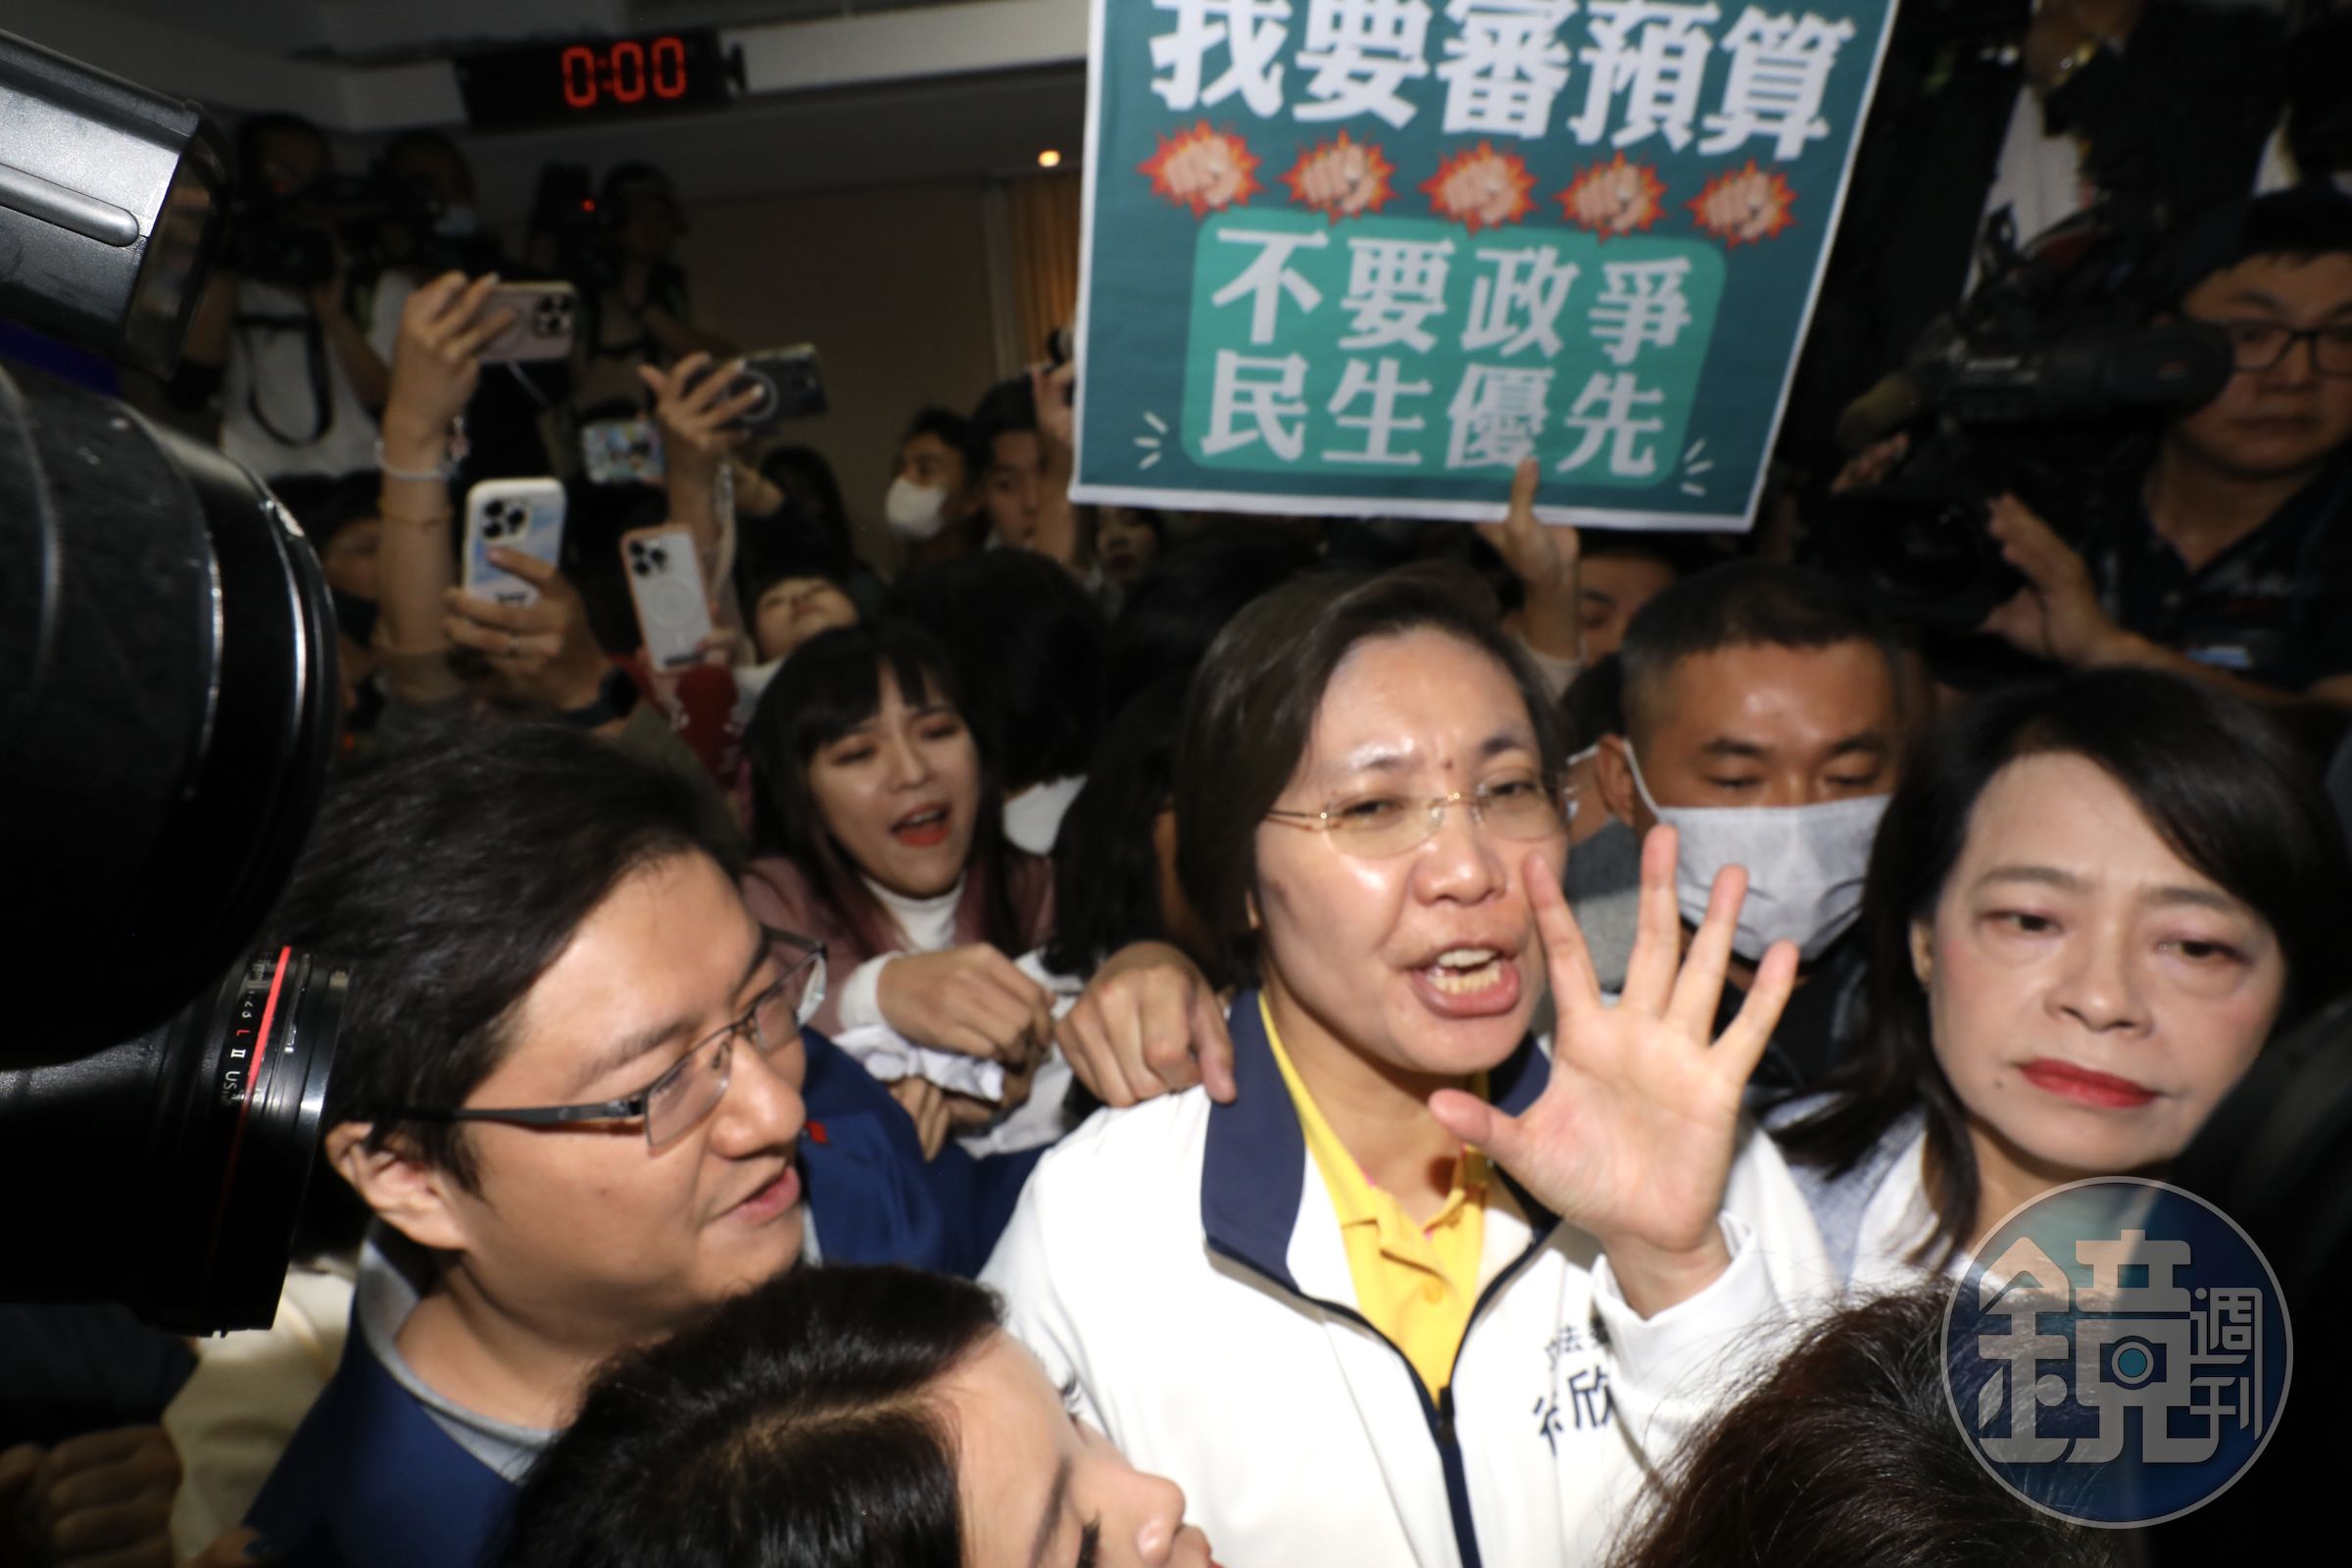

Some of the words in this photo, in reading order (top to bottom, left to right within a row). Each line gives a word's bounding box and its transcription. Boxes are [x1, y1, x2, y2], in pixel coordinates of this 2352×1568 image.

[562, 36, 687, 108] 0:00
[1149, 0, 1855, 161] 我要審預算
[1211, 227, 1692, 366] 不要政爭
[1200, 350, 1664, 477] 民生優先
